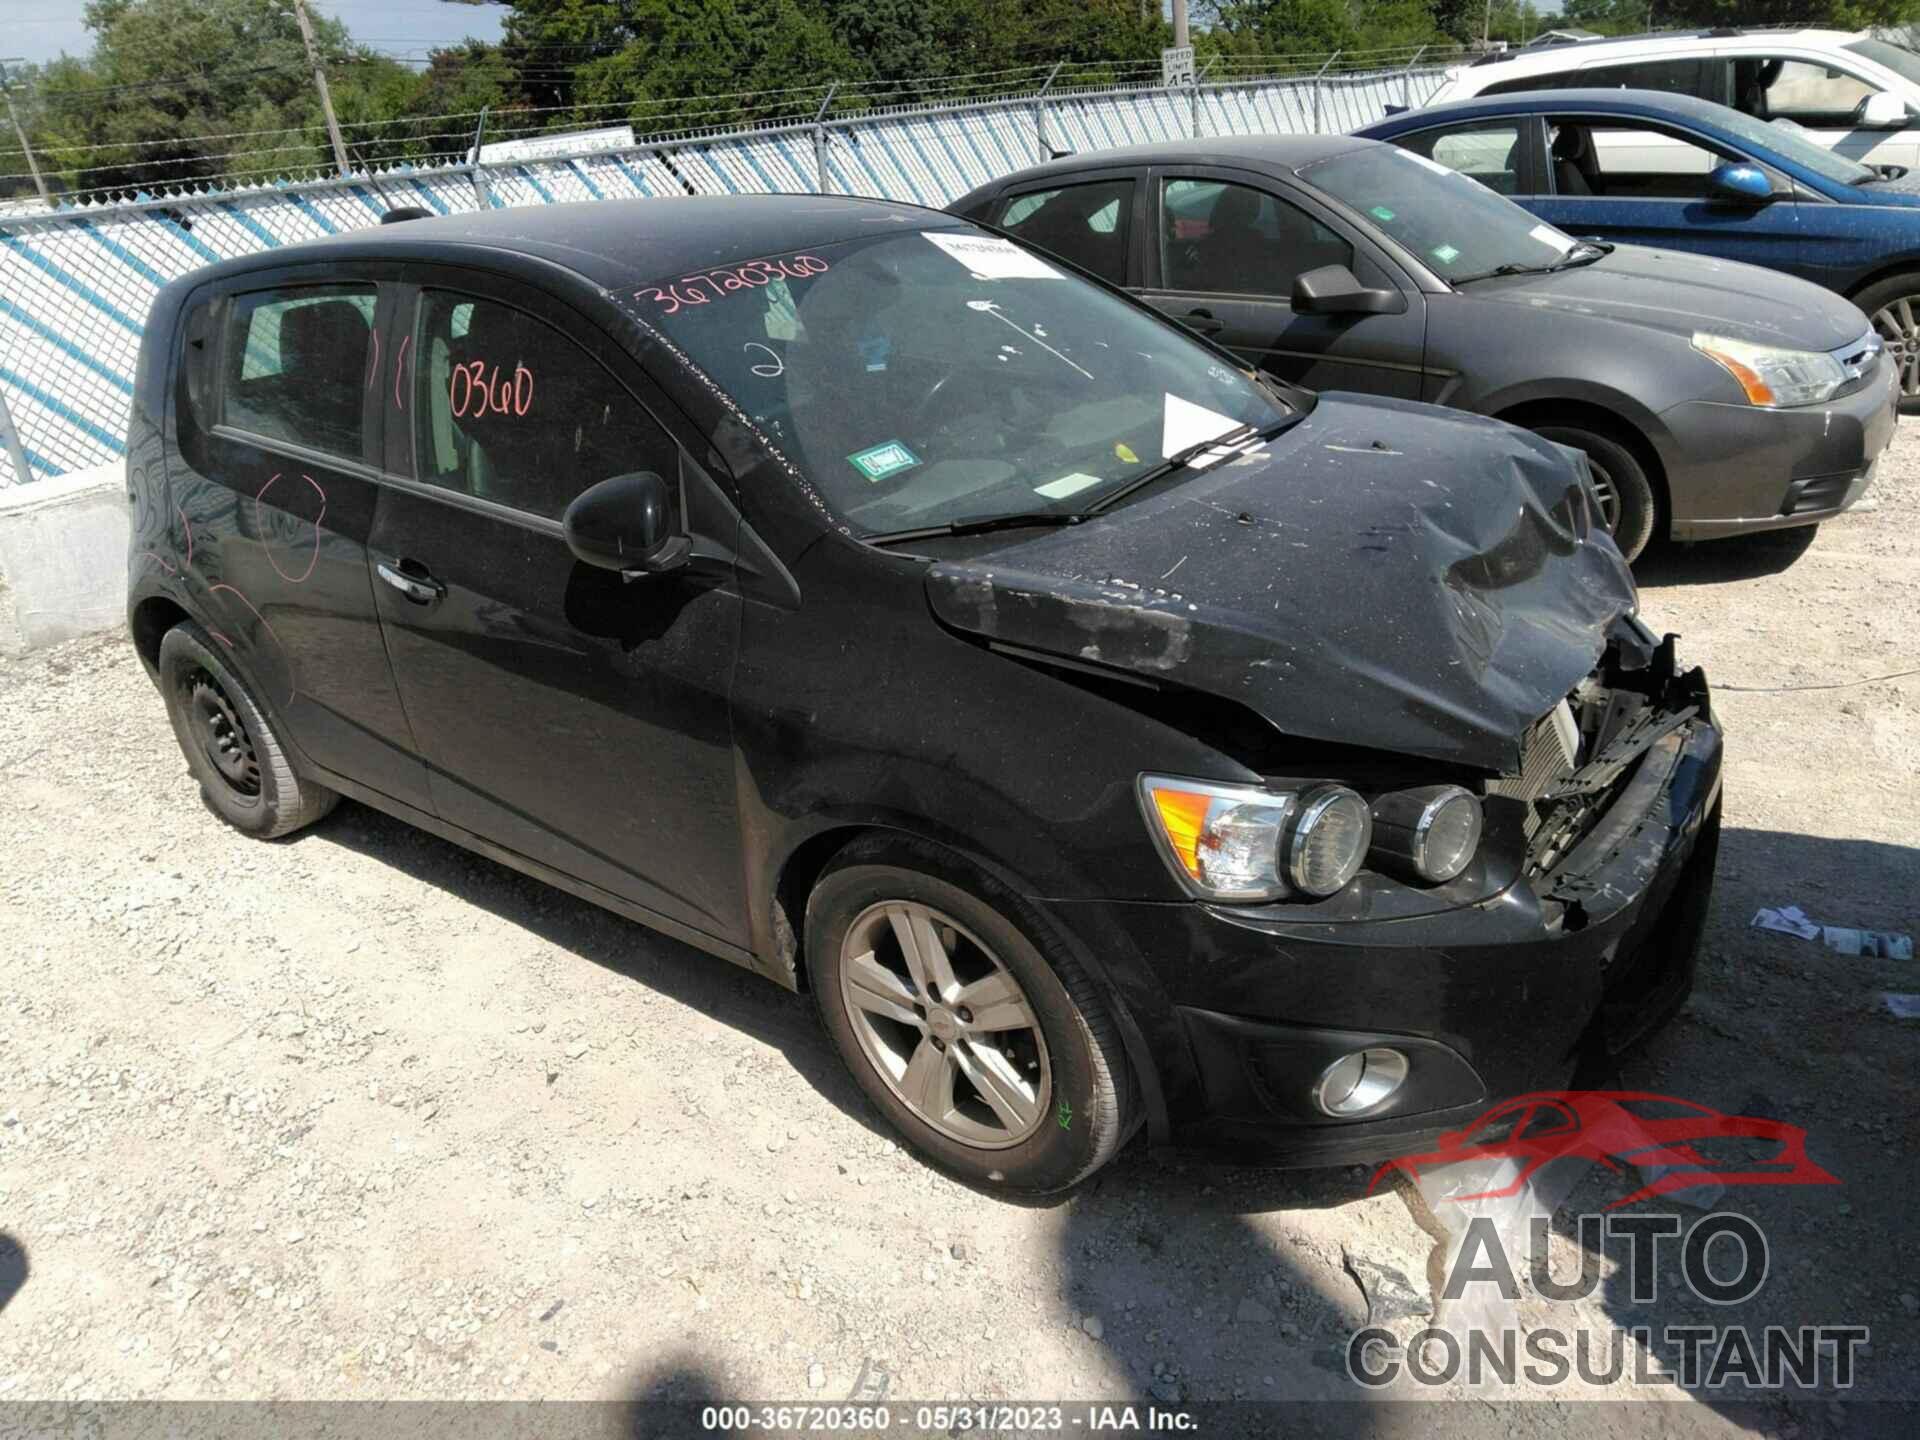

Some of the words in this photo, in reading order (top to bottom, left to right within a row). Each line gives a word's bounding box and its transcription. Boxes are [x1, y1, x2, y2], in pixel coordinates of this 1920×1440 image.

[1165, 51, 1191, 63] SPEED
[1167, 62, 1189, 72] LIMIT
[1168, 72, 1192, 86] 45
[633, 256, 829, 313] 36720360
[451, 361, 533, 417] 0360
